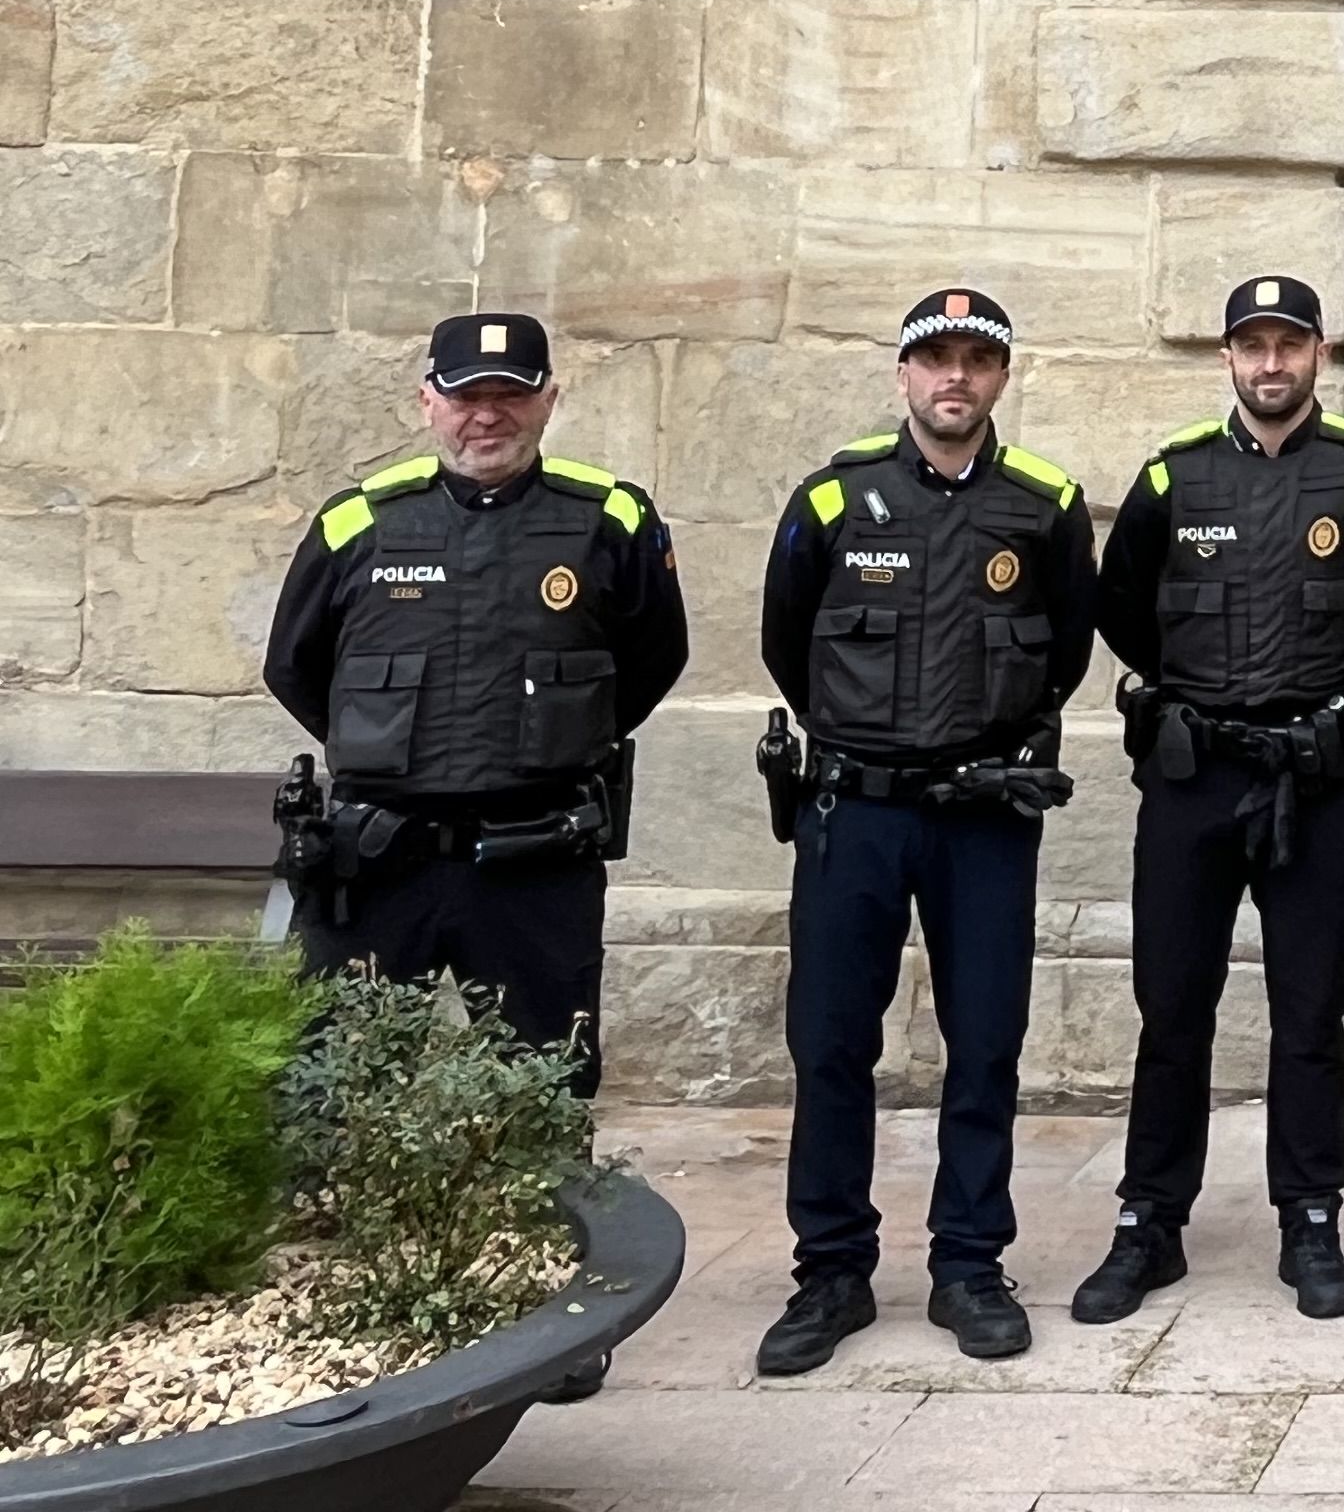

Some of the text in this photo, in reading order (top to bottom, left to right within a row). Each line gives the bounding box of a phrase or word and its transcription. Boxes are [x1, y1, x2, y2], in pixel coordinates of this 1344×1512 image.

[1177, 525, 1238, 543] POLICIA
[845, 551, 911, 569] POLICIA
[371, 566, 447, 583] POLICIA
